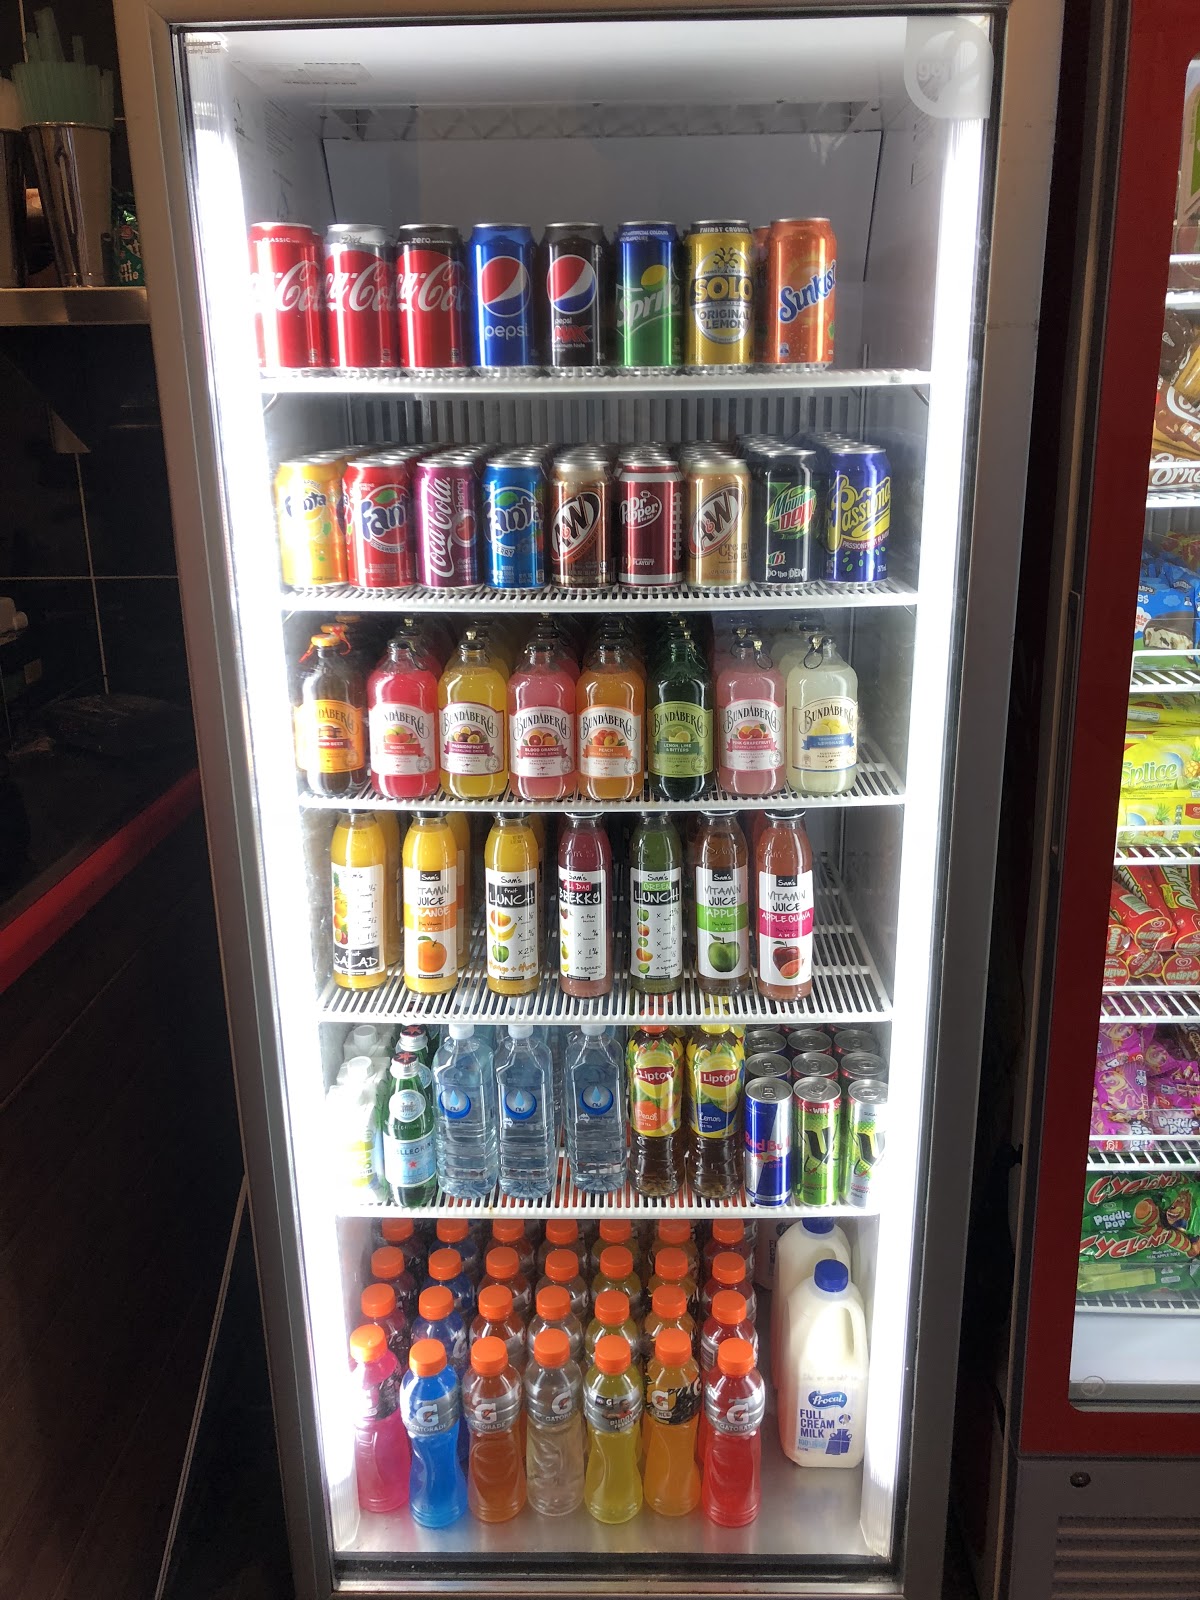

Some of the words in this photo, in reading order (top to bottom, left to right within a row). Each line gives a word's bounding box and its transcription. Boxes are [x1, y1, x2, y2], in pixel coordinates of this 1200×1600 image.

[694, 276, 754, 302] SOLO
[779, 259, 836, 323] Sunkist
[616, 282, 680, 328] Sprite
[700, 309, 750, 320] ORIGINAL
[554, 317, 573, 325] pepsi
[705, 319, 745, 330] LEMON
[484, 322, 529, 340] pepsi
[457, 479, 466, 513] cherry
[284, 491, 327, 518] Fnta
[632, 497, 646, 511] Dr
[620, 500, 659, 525] Pepper
[828, 478, 890, 553] Passiona
[494, 546, 516, 558] ERRY
[718, 543, 748, 557] Crem
[727, 551, 748, 561] Soa
[766, 568, 777, 577] DO
[651, 709, 708, 738] BUNDABERG
[723, 705, 781, 734] BUNDABERG
[798, 704, 856, 735] BUNDABERG
[513, 712, 571, 741] BUNDABERG
[580, 712, 638, 741] BUNDABERG
[1121, 761, 1178, 787] Splice
[421, 873, 440, 881] Sam's
[501, 875, 522, 884] Sam's
[569, 873, 588, 881] Sam's
[648, 873, 669, 882] Sam's
[714, 873, 732, 881] Sam's
[417, 884, 450, 896] ITAMIN
[643, 882, 672, 890] GREEN
[704, 884, 741, 896] VITAMIN
[489, 890, 535, 906] LUNCH
[634, 887, 680, 904] LUNCH
[708, 897, 737, 906] JUICE
[417, 897, 446, 907] JUICE
[772, 902, 801, 912] JUICE
[417, 906, 451, 918] RANGE
[706, 907, 741, 919] APPLE
[761, 912, 788, 922] APPLE
[1166, 969, 1200, 980] CALIPPO
[638, 1069, 673, 1081] Lipton
[703, 1073, 736, 1084] Lipton
[637, 1109, 658, 1122] Peach
[699, 1111, 721, 1122] Lemon
[1157, 1115, 1199, 1129] Paddle
[1169, 1124, 1192, 1135] Pop
[745, 1130, 765, 1152] Red
[767, 1136, 790, 1152] Bul
[1087, 1173, 1178, 1205] CYCLONE
[1093, 1210, 1132, 1226] Paddle
[1104, 1220, 1126, 1229] Pop
[551, 1390, 572, 1414] G
[651, 1390, 668, 1410] G
[416, 1403, 439, 1427] G
[475, 1402, 498, 1423] G
[545, 1412, 573, 1423] GATORA
[727, 1404, 749, 1424] G
[800, 1408, 824, 1420] FULL
[473, 1421, 506, 1431] ATORADE
[800, 1418, 835, 1429] CREAM
[800, 1427, 825, 1439] MILK
